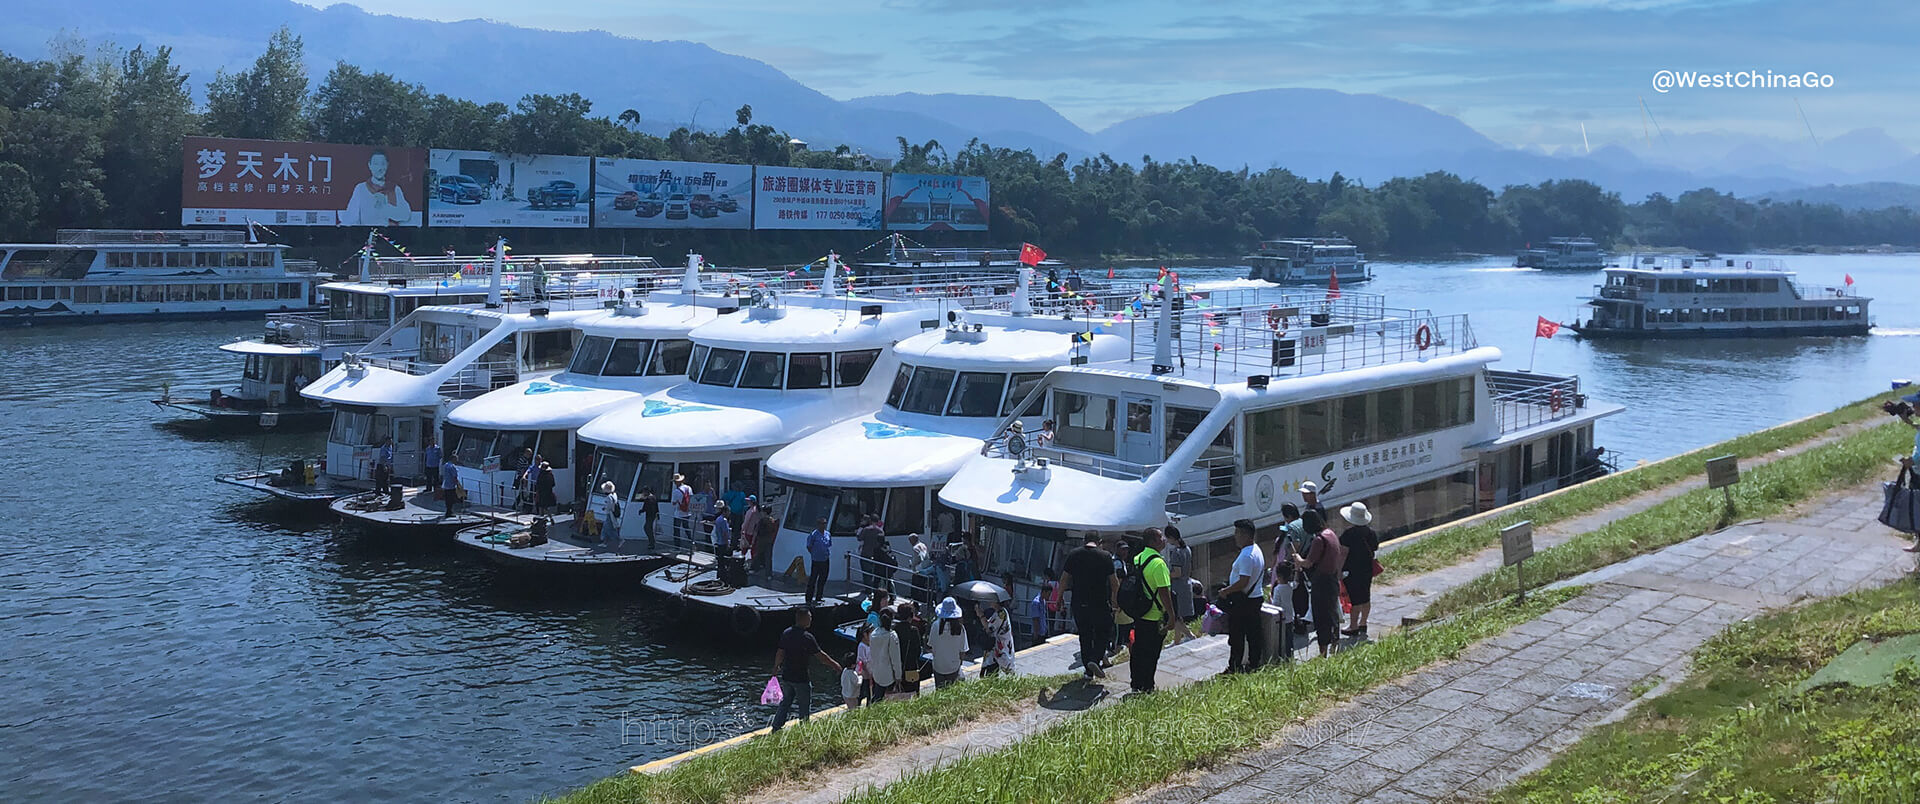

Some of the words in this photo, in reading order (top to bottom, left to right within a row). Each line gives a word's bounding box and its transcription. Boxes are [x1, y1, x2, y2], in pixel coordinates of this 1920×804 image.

[196, 148, 332, 183] 梦天木门
[762, 175, 877, 196] 旅游圈媒体专业运营商
